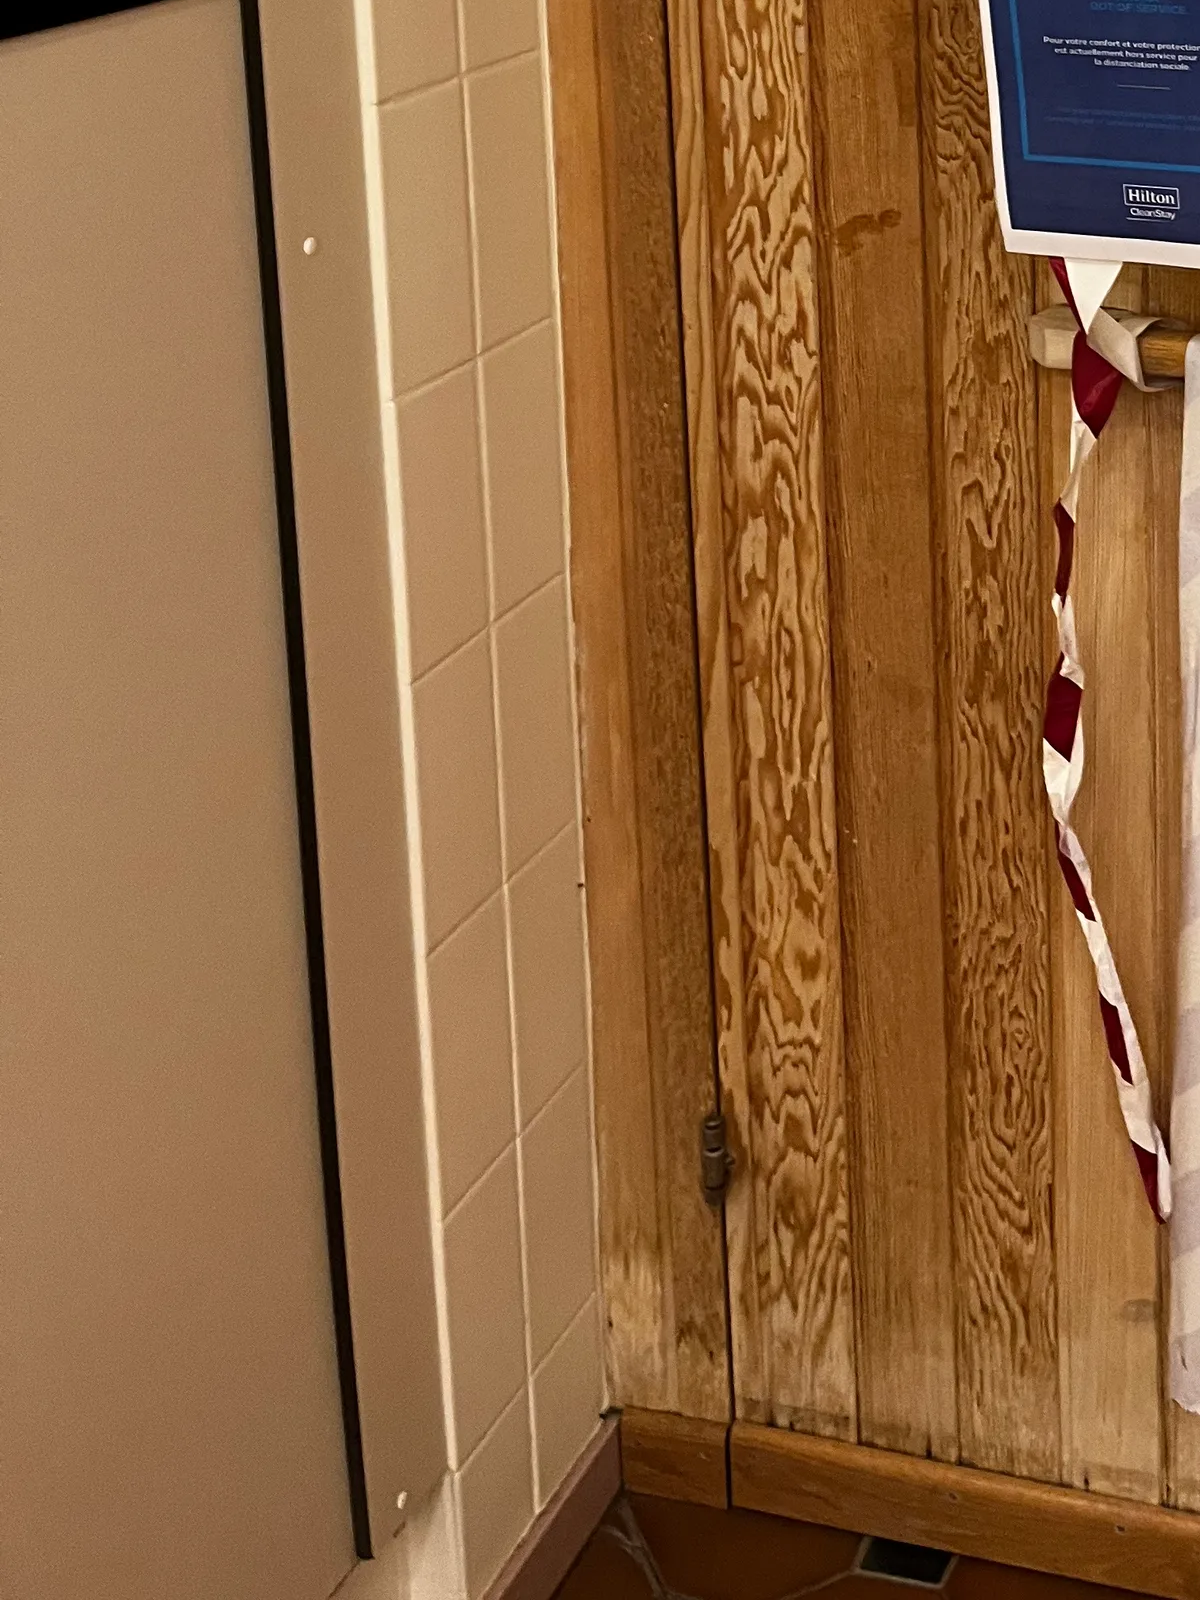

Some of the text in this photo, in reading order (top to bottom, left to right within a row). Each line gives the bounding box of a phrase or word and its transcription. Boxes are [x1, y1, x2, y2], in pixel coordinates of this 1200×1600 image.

[1088, 38, 1121, 48] confort
[1121, 40, 1131, 48] et
[1103, 59, 1158, 69] distanciation
[1128, 188, 1176, 205] Hilton
[1130, 207, 1176, 221] CleanStay
